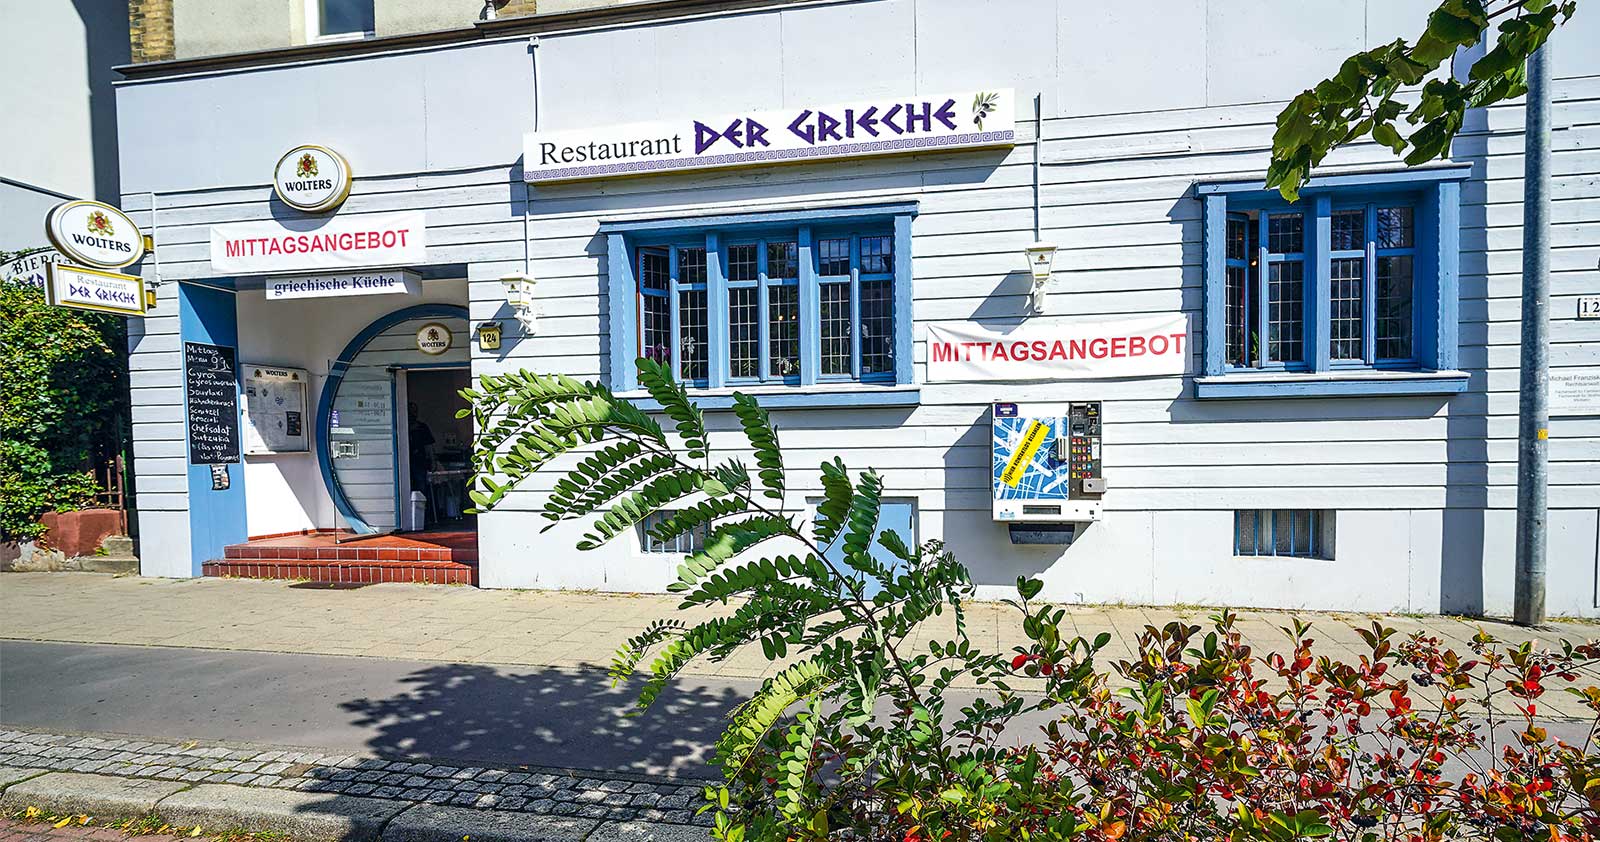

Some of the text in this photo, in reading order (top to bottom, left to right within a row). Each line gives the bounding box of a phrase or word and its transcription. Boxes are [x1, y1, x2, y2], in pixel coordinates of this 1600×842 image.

[540, 99, 958, 165] Restaurant DER GRIECHE
[285, 179, 332, 192] WOLTERS
[72, 233, 131, 253] WOLTERS
[225, 230, 409, 258] MITTAGSANGEBOT
[77, 275, 127, 290] Restaurant
[274, 275, 395, 296] griechische Küche
[69, 283, 136, 305] DER GRIECHE
[482, 333, 497, 343] 124
[932, 333, 1187, 363] MITTAGSANGEBOT
[188, 368, 217, 380] Gyros
[265, 369, 289, 377] WOLTERS
[192, 424, 232, 436] Chefsalat
